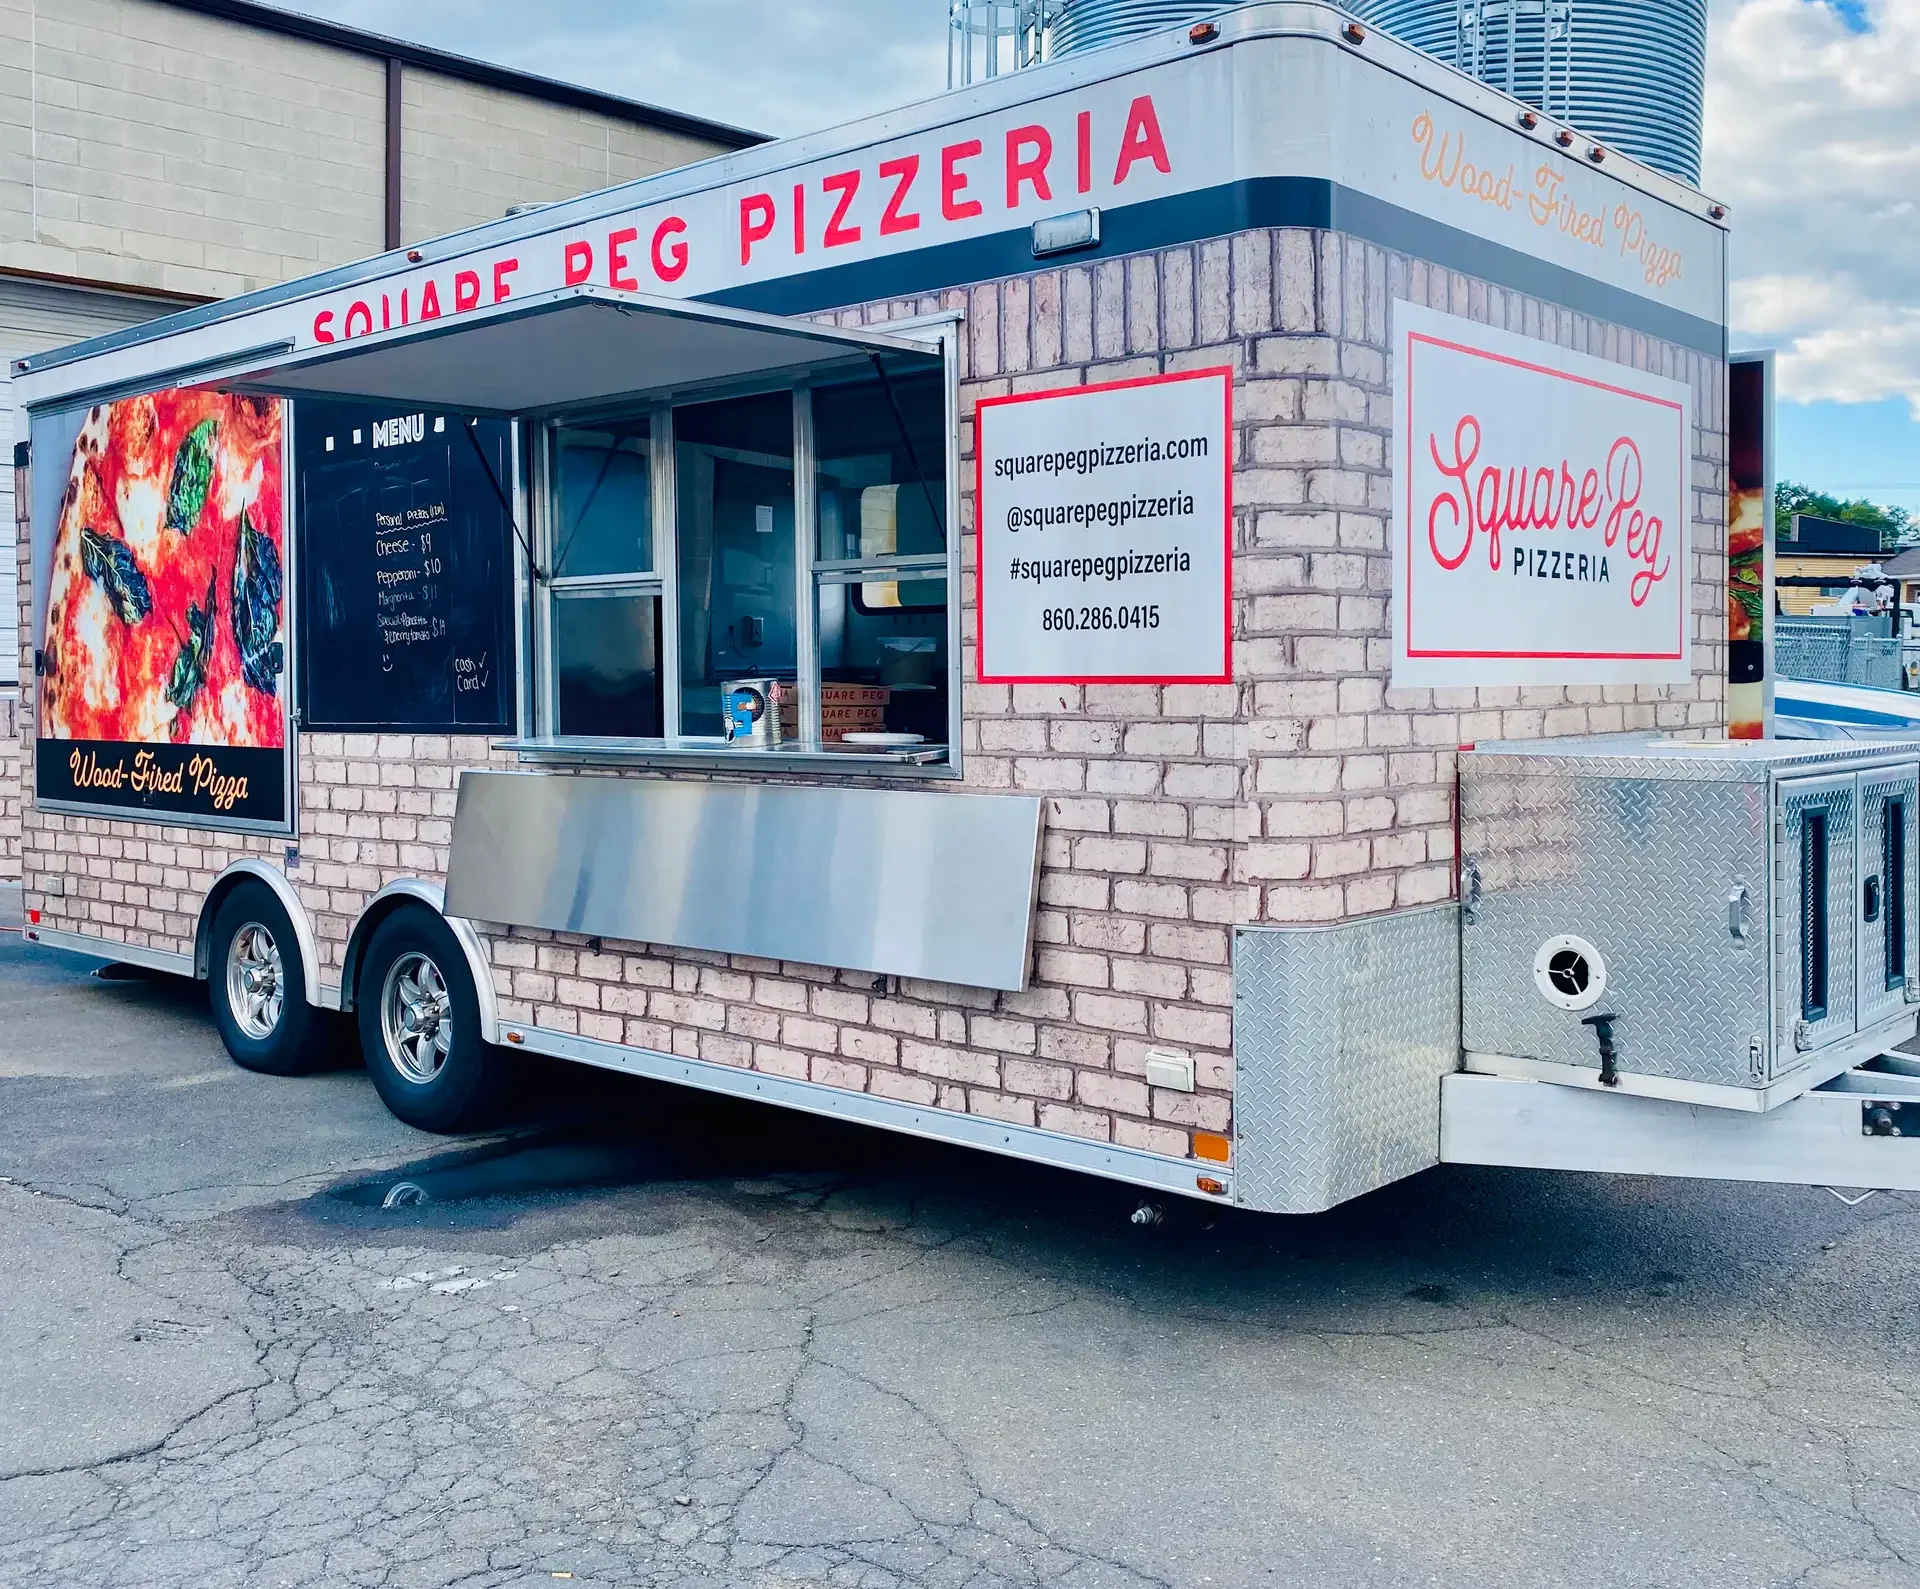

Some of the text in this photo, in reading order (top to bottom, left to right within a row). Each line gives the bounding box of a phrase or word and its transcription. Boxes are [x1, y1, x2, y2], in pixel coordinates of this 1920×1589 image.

[1411, 109, 1683, 288] Wood-Fired Pizza
[313, 95, 1171, 345] SQUARE PEG PIZZERIA
[372, 413, 425, 449] MENU
[994, 436, 1209, 481] squarepegpizzeria.com
[1006, 489, 1195, 533] @squarepegpizzeria
[1427, 414, 1671, 608] Square Peg
[376, 540, 409, 556] Cheese
[420, 532, 432, 554] $9
[424, 558, 441, 578] $10
[1010, 547, 1191, 585] #squarepegpizzeria
[1513, 547, 1610, 583] PIZZERIA
[1042, 604, 1160, 631] 860.286.0415
[857, 708, 878, 718] PEG
[862, 690, 884, 700] PEG
[69, 747, 249, 811] Wood-Fired Pizza
